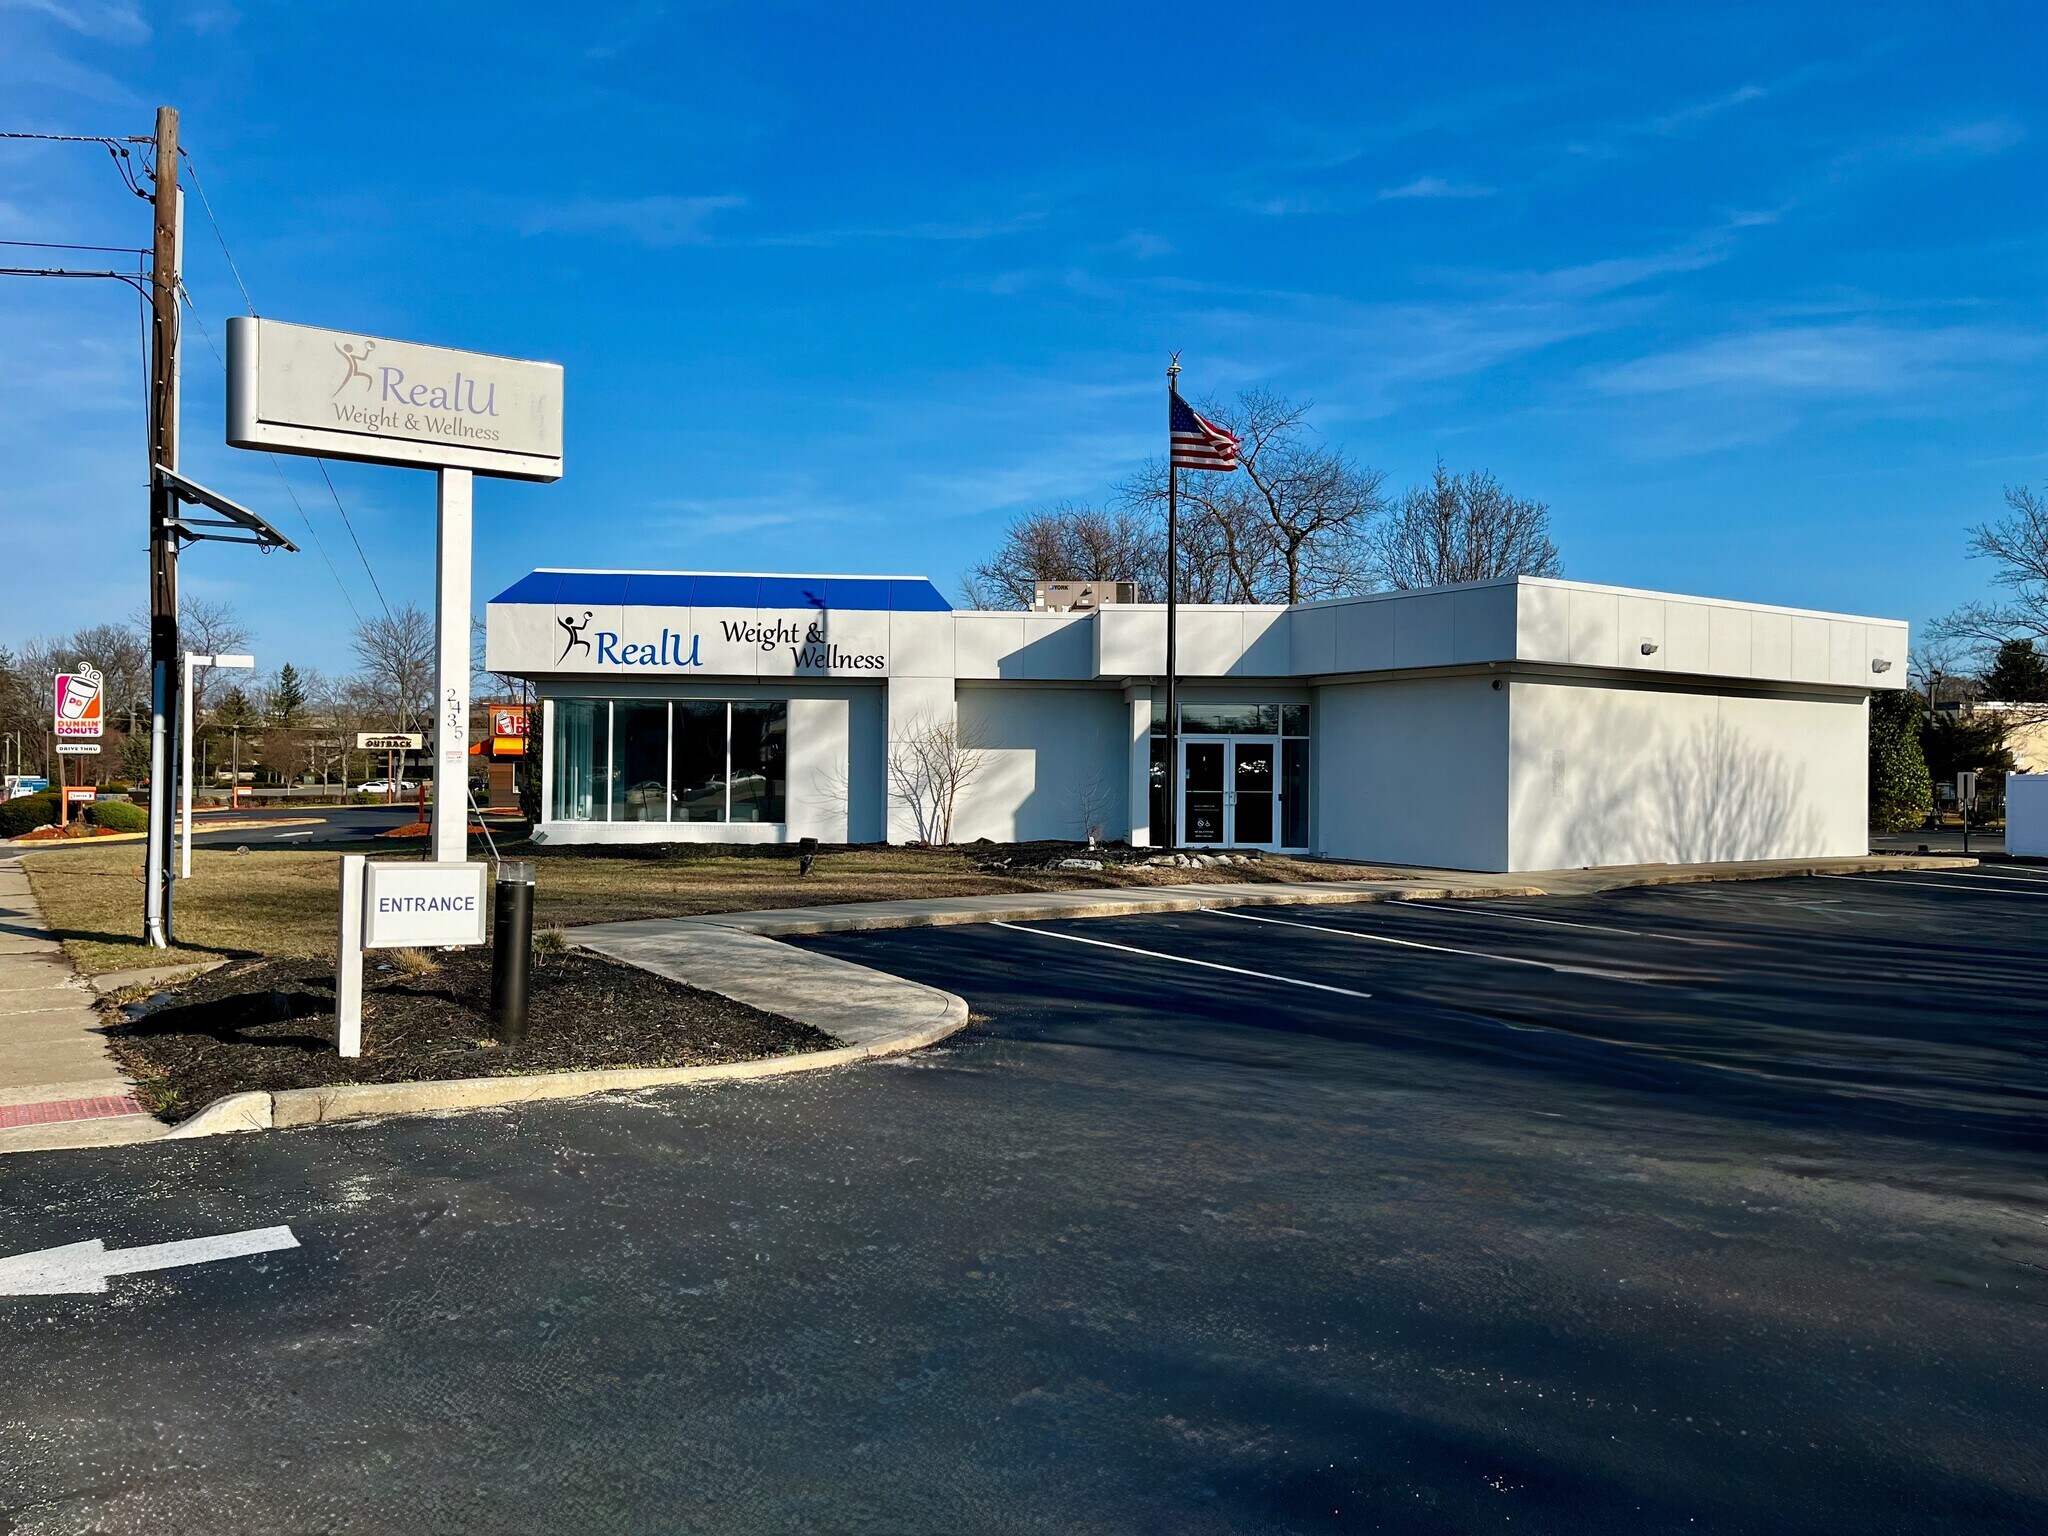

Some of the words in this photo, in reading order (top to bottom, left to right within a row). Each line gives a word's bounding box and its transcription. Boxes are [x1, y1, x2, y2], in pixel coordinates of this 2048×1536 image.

[378, 366, 499, 417] RealU
[332, 402, 399, 432] Weight
[404, 413, 420, 432] &
[424, 415, 500, 441] Wellness
[594, 628, 704, 667] RealU
[720, 618, 800, 651] Weight
[805, 622, 825, 644] &
[789, 644, 885, 670] Wellness
[446, 688, 463, 740] 2435
[365, 740, 412, 748] OUTBACK
[379, 896, 475, 913] ENTRANCE
